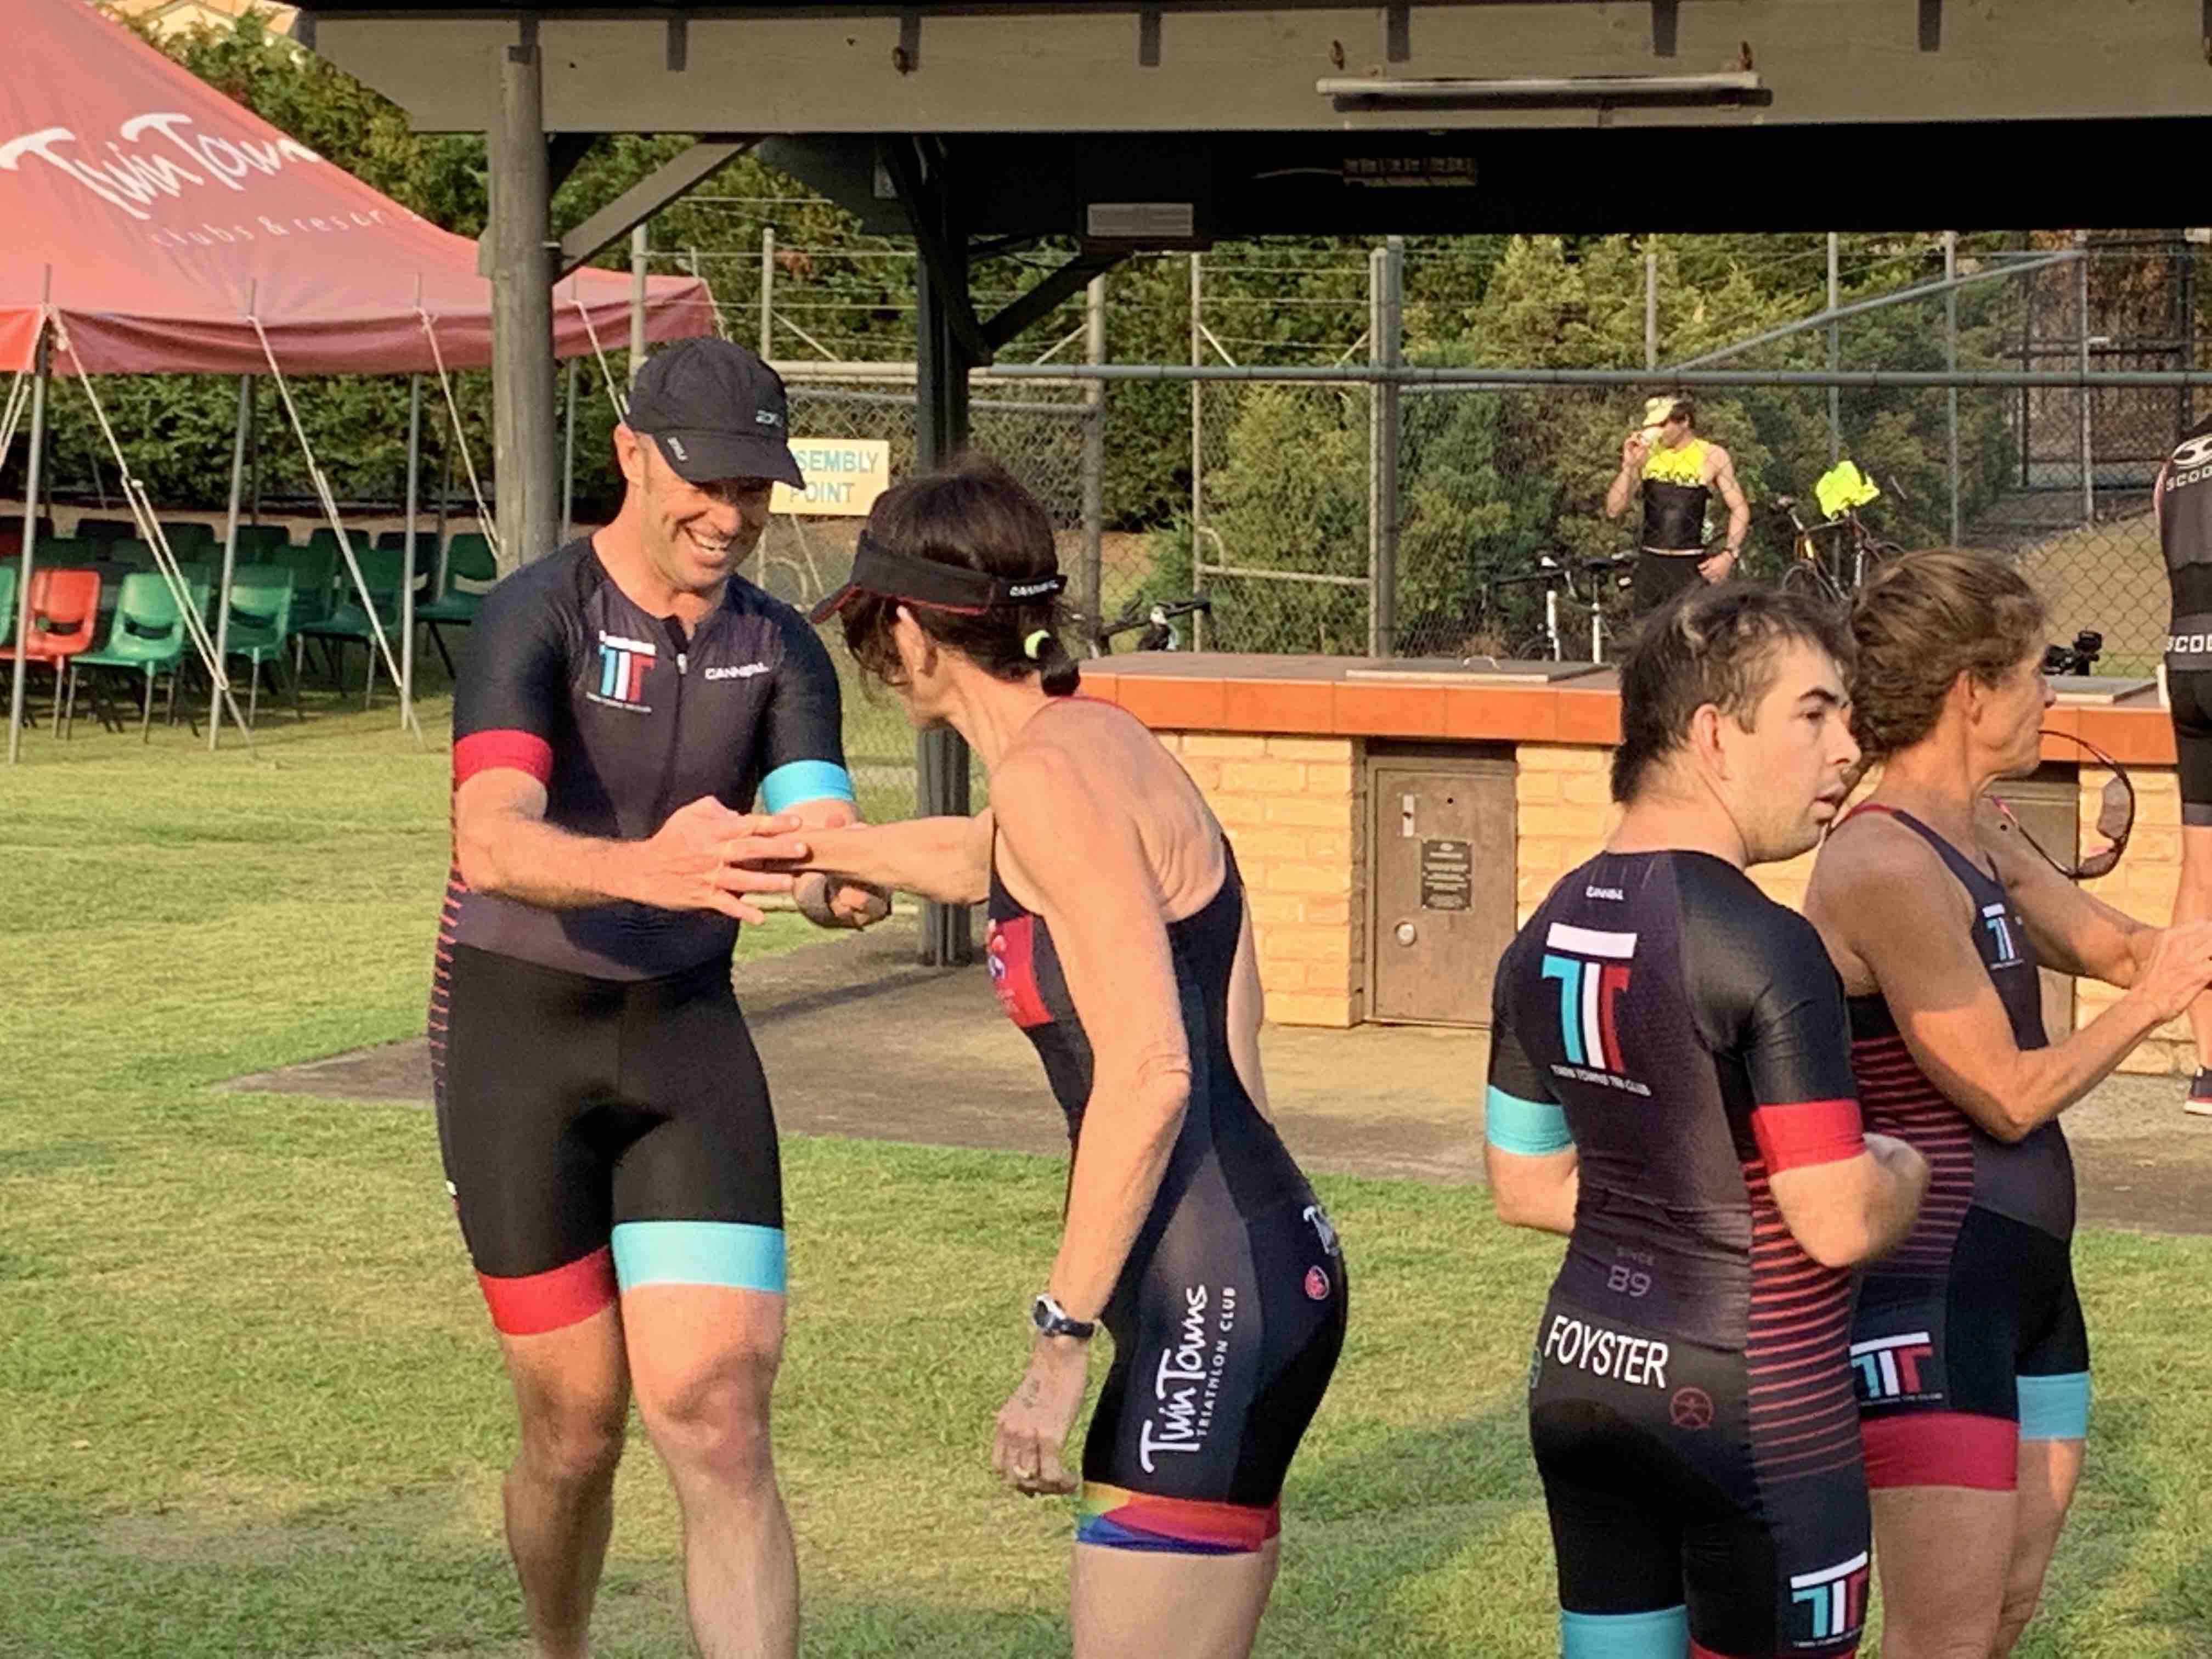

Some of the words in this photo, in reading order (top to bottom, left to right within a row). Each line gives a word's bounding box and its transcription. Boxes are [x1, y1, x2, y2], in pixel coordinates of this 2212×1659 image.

[0, 127, 204, 219] Twin
[150, 223, 254, 247] clubs
[257, 216, 289, 235] &
[1607, 1264, 1651, 1297] 89
[1156, 1284, 1208, 1400] Towns
[1197, 1340, 1228, 1436] TRIATHLON
[1220, 1286, 1237, 1331] CLUB
[1544, 1314, 1668, 1389] FOYSTER
[1140, 1387, 1200, 1473] Twin
